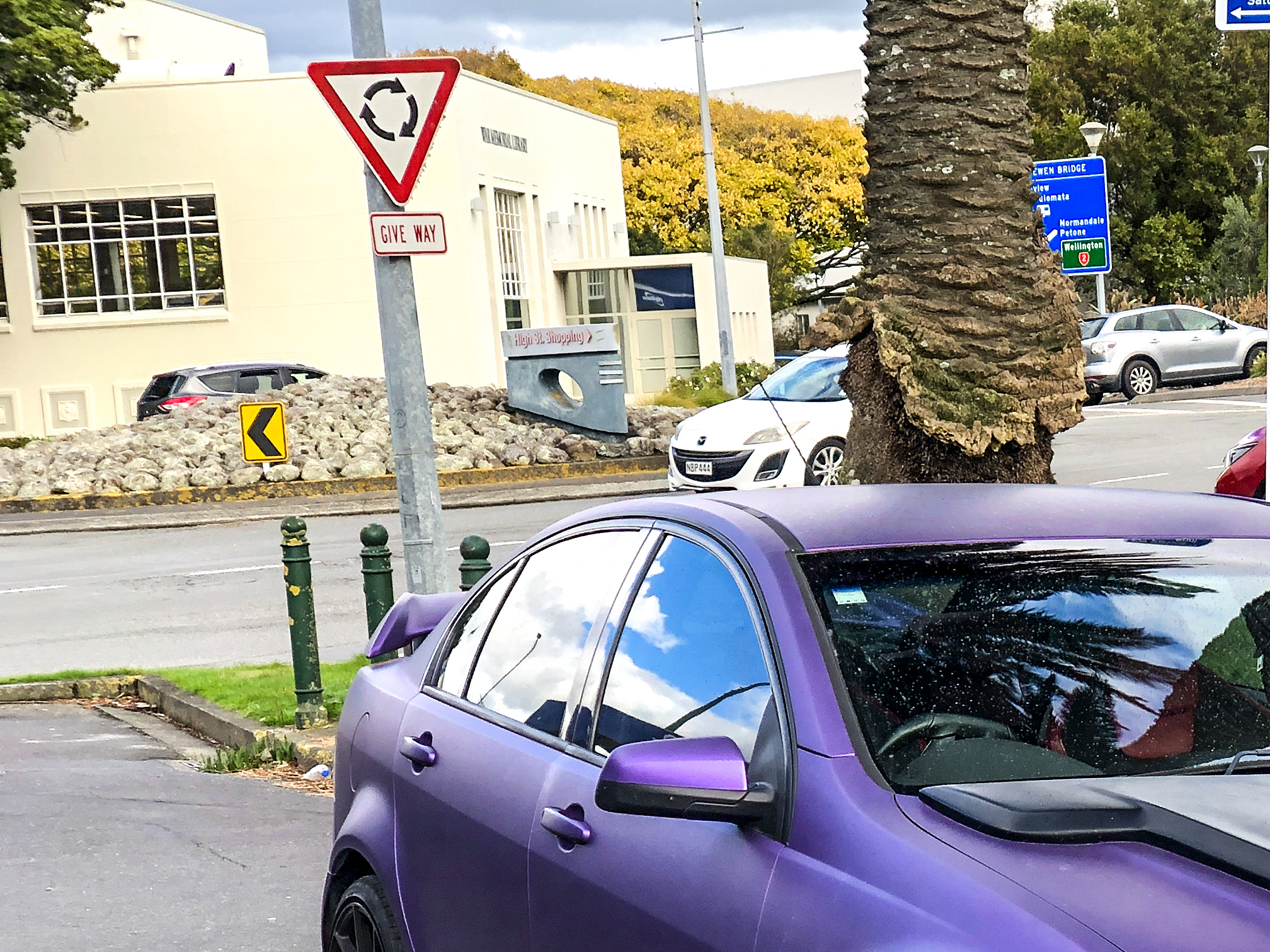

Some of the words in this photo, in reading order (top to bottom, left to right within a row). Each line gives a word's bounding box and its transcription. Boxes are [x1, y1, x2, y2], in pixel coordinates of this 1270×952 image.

[1057, 163, 1087, 174] BRIDGE
[1059, 217, 1105, 227] Normandale
[380, 224, 407, 244] GIVE
[413, 224, 436, 243] WAY
[1059, 229, 1087, 237] Petone
[1063, 242, 1104, 252] Wellington
[1082, 254, 1088, 262] 2
[515, 332, 533, 349] High
[545, 329, 585, 346] Shopping
